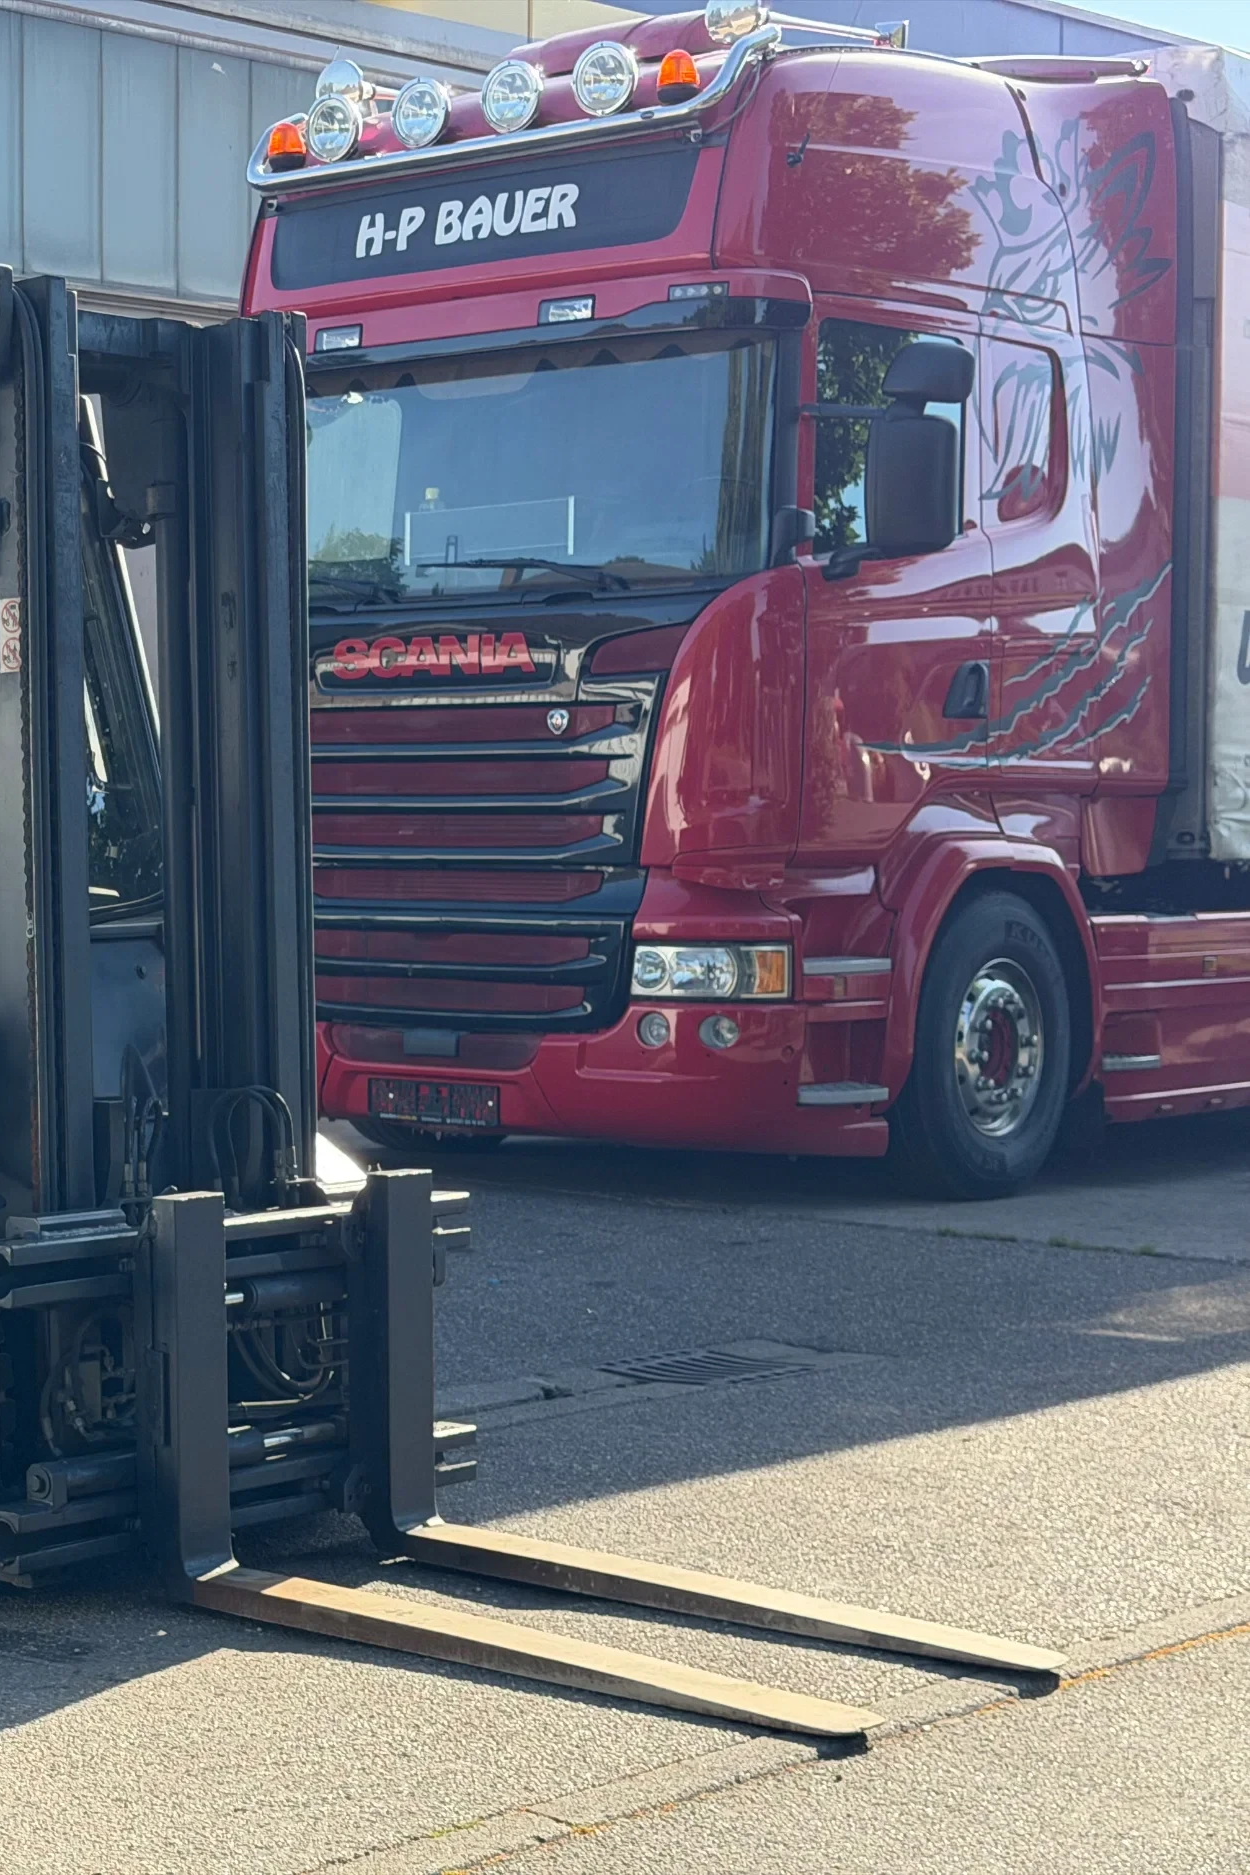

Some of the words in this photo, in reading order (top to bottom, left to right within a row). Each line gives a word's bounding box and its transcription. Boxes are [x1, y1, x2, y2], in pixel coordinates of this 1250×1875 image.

[355, 212, 425, 258] H-P
[435, 183, 579, 245] BAUER
[333, 632, 536, 680] SCANIA
